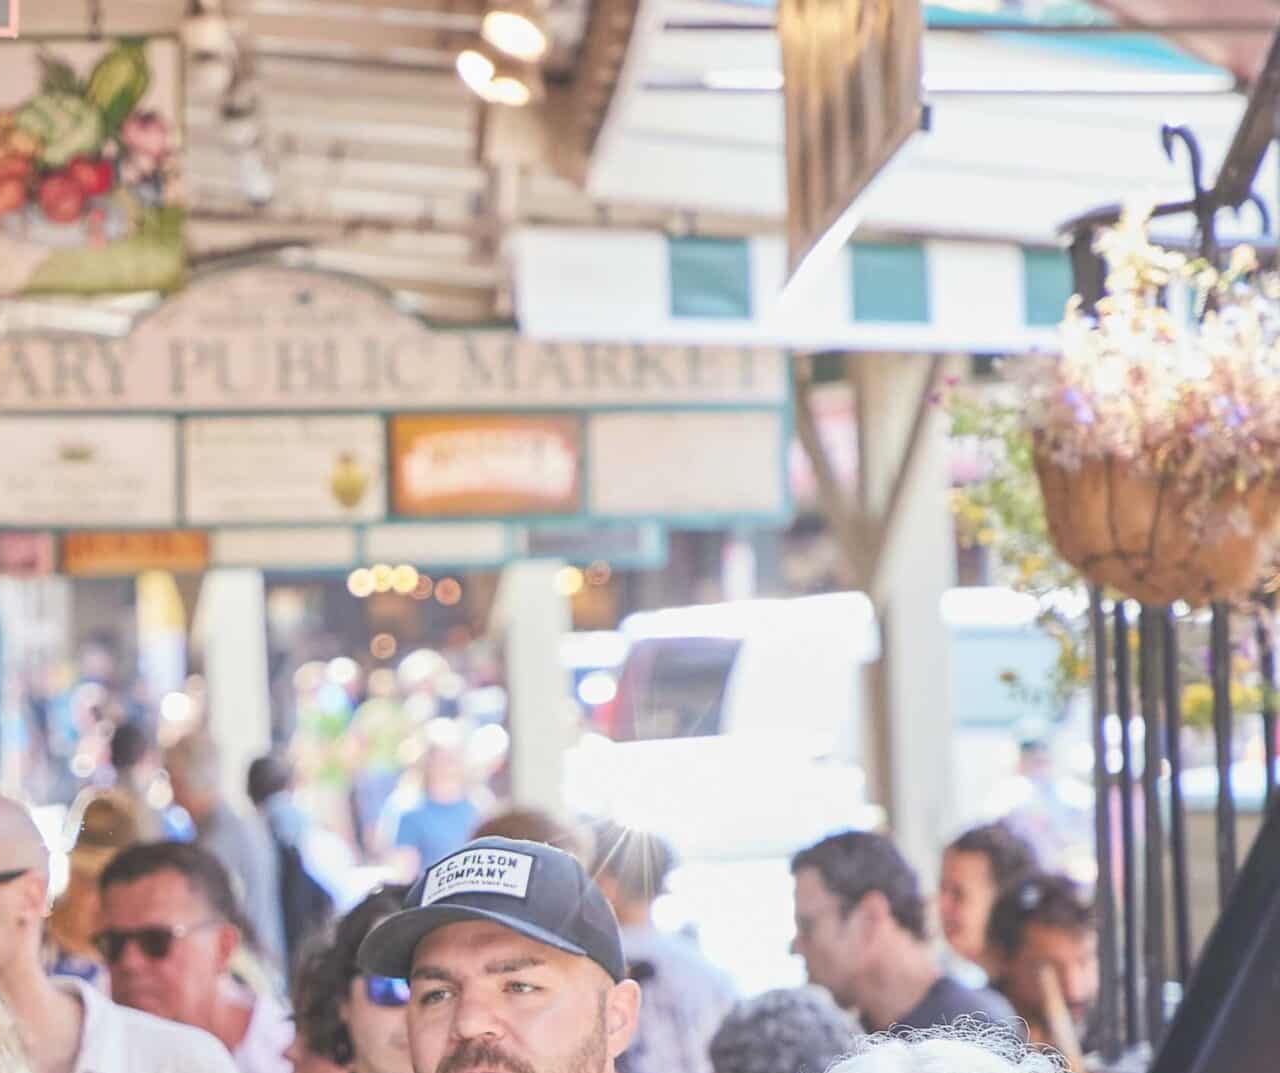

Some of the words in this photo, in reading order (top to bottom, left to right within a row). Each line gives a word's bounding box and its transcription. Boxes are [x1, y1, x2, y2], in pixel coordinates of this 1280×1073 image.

[168, 337, 432, 394] PUBLIC
[458, 335, 764, 392] MARKET
[463, 854, 518, 868] FILSON
[438, 867, 507, 887] COMPANY
